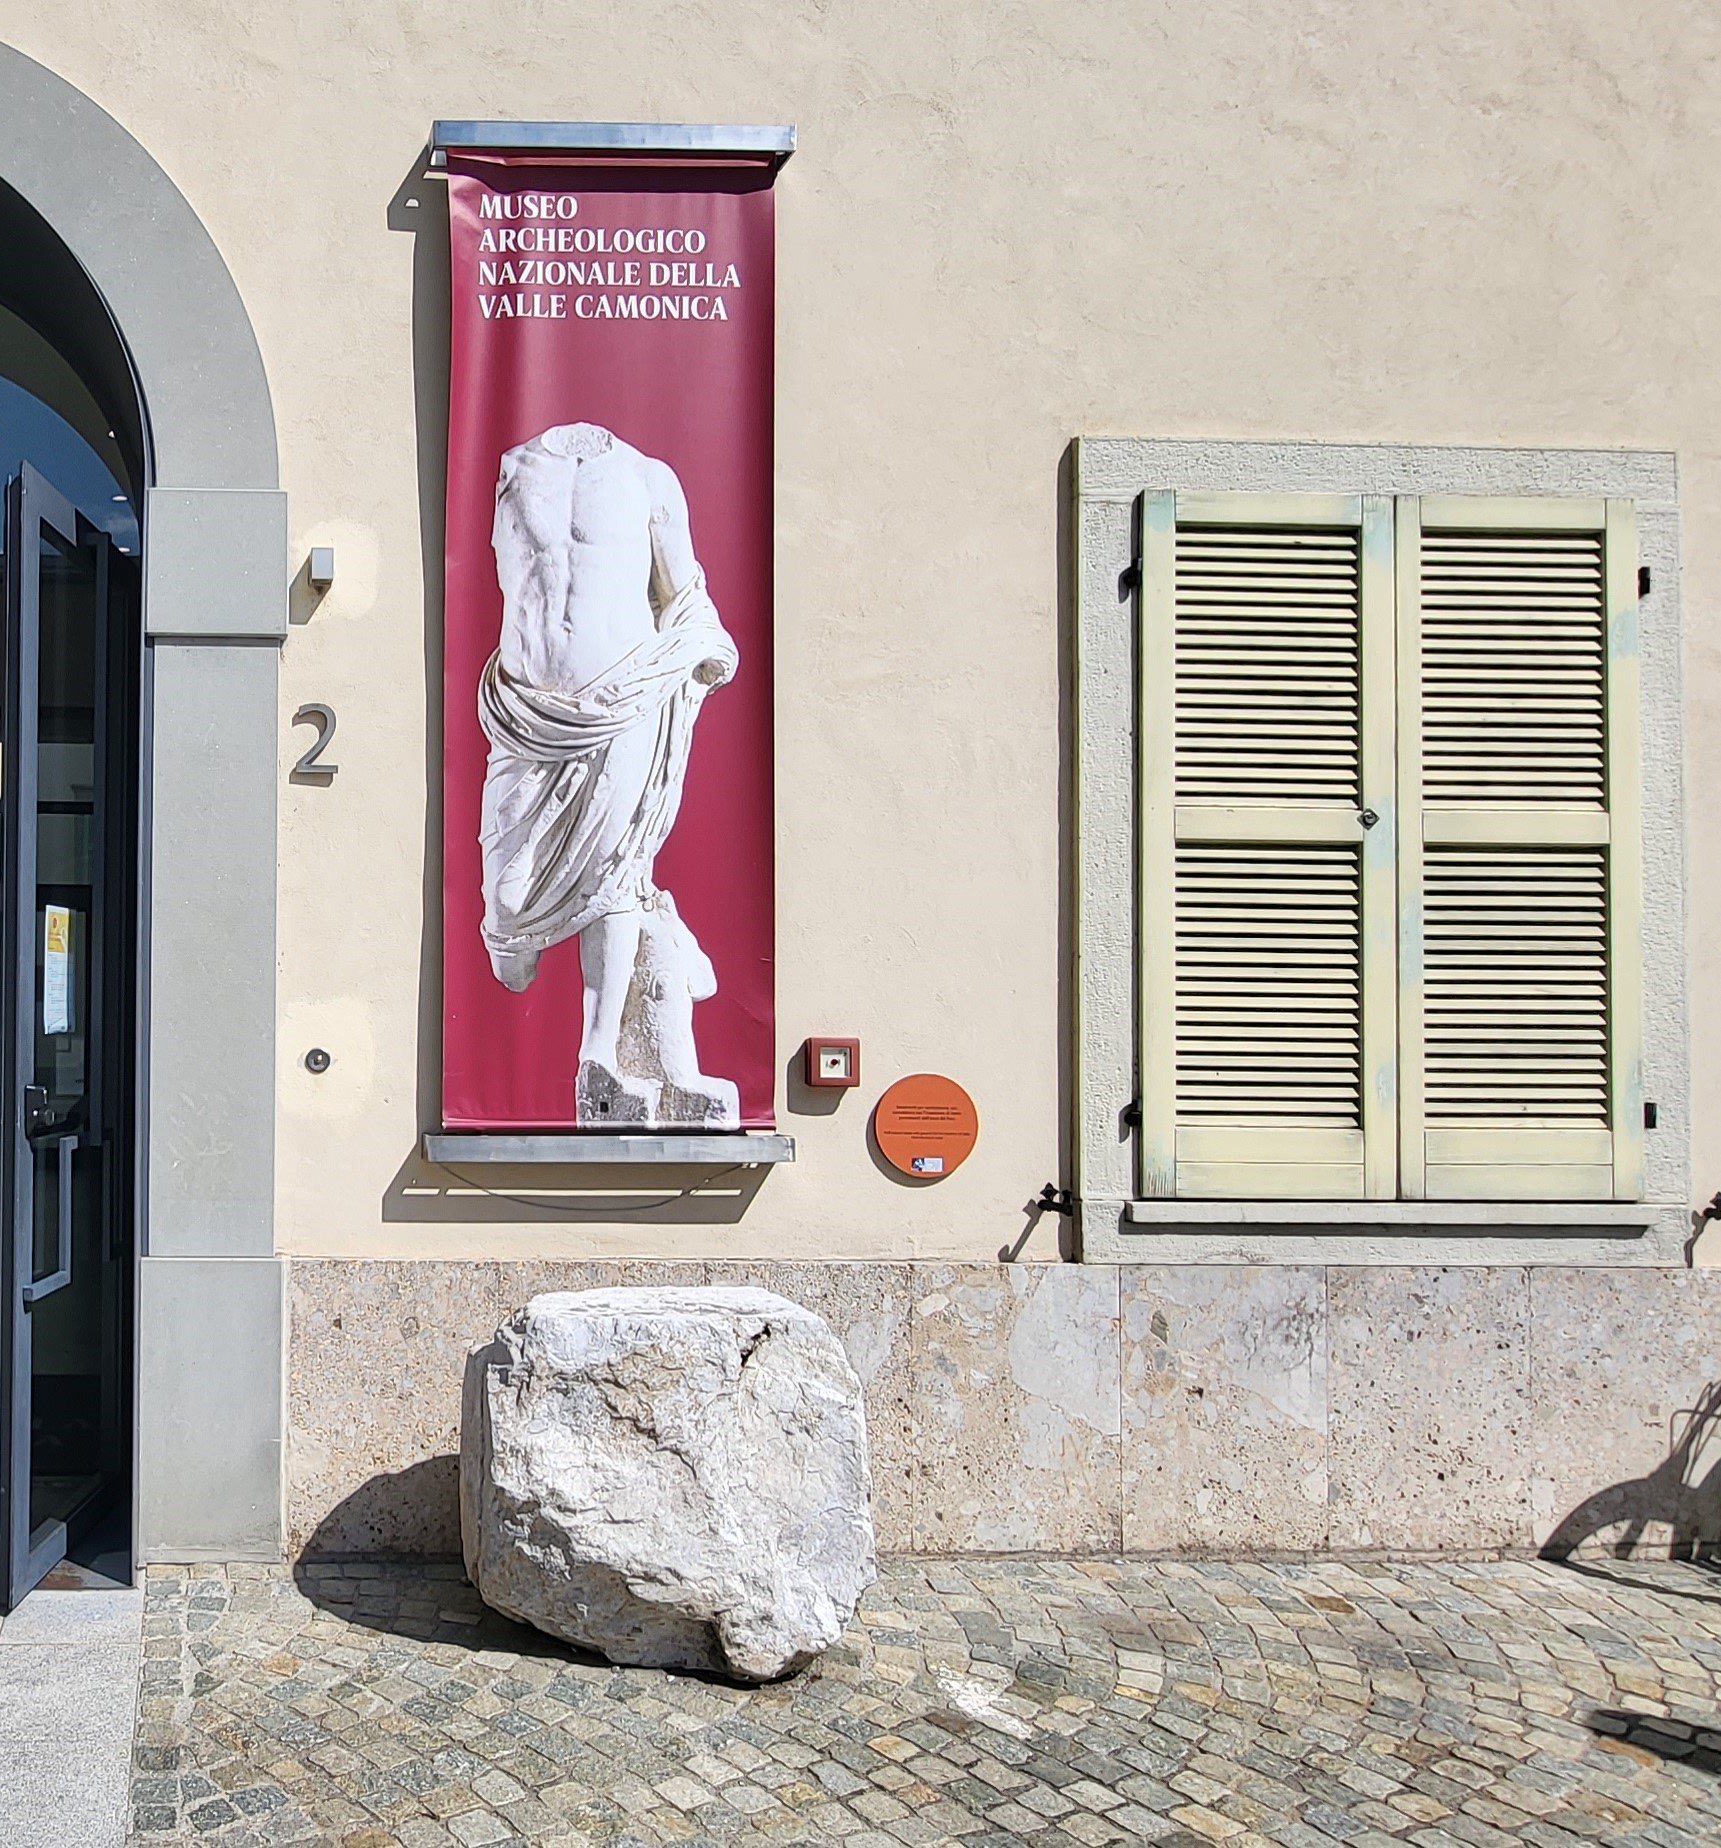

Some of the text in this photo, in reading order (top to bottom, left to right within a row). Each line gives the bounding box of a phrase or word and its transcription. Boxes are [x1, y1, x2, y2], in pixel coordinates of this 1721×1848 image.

[478, 193, 578, 220] MUSEO
[478, 227, 706, 254] ARCHEOLOGICO
[478, 260, 741, 288] NAZIONALE DELLA
[478, 293, 729, 322] VALLE CAMONICA
[296, 702, 338, 775] 2
